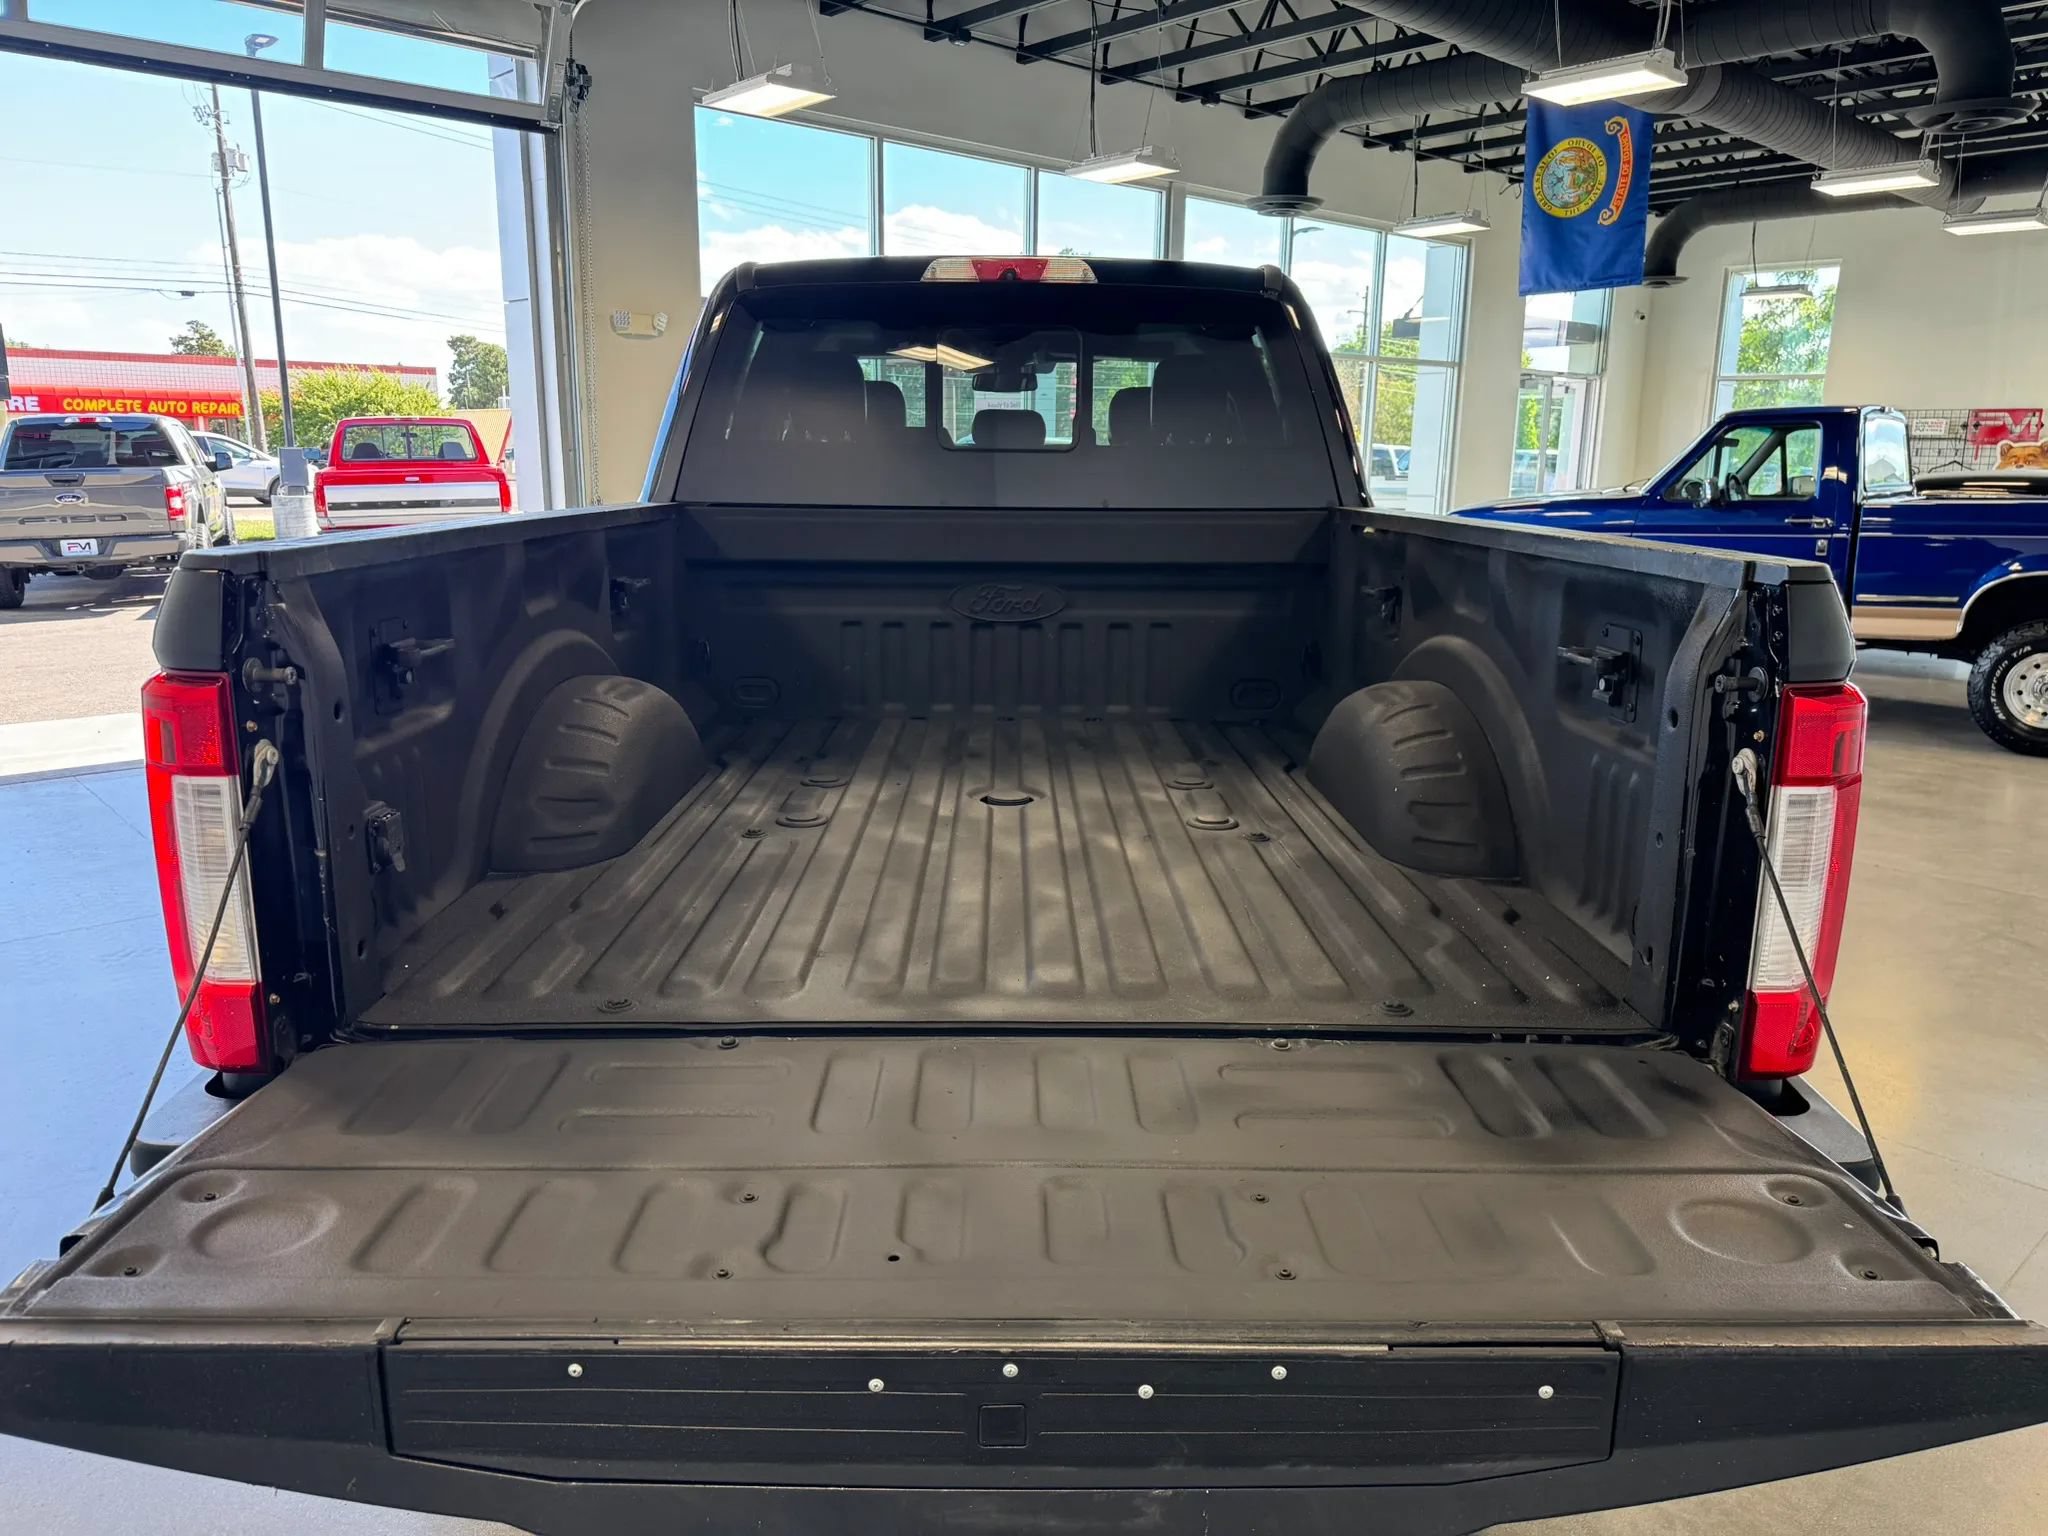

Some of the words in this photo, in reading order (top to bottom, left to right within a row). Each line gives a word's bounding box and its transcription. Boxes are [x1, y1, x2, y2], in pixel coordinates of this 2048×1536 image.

[1620, 134, 1631, 161] IDAHO
[1621, 163, 1630, 176] OF
[1535, 186, 1553, 212] GREAT
[1613, 176, 1628, 207] STATE
[1564, 207, 1580, 216] THE
[62, 398, 142, 412] COMPLETE
[147, 400, 188, 414] AUTO
[192, 402, 241, 415] REPAIR
[969, 583, 1042, 614] Ford
[2011, 645, 2032, 658] T/A
